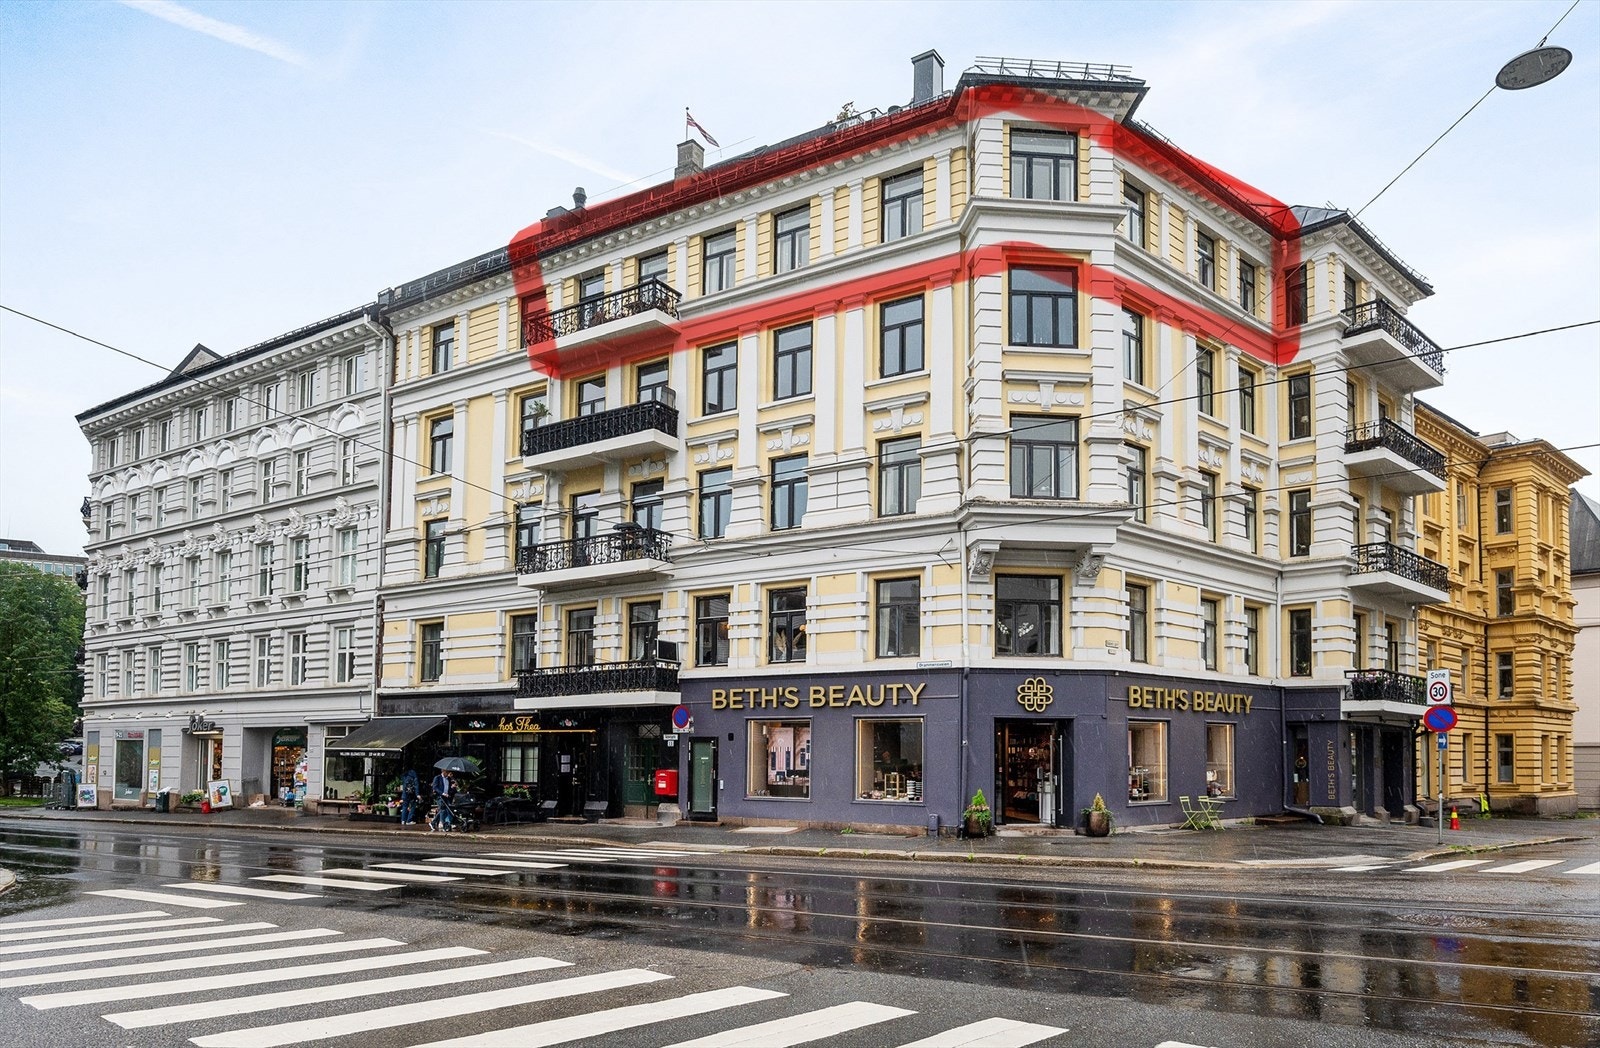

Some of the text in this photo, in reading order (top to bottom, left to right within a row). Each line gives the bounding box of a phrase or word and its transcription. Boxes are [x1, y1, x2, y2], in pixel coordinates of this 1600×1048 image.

[711, 682, 927, 710] BETH'S BEAUTY
[1127, 685, 1254, 714] BETH'S BEAUTY
[1433, 686, 1445, 697] 30
[498, 716, 542, 731] hos Thea
[1327, 739, 1336, 800] BETH'S BEAUTY
